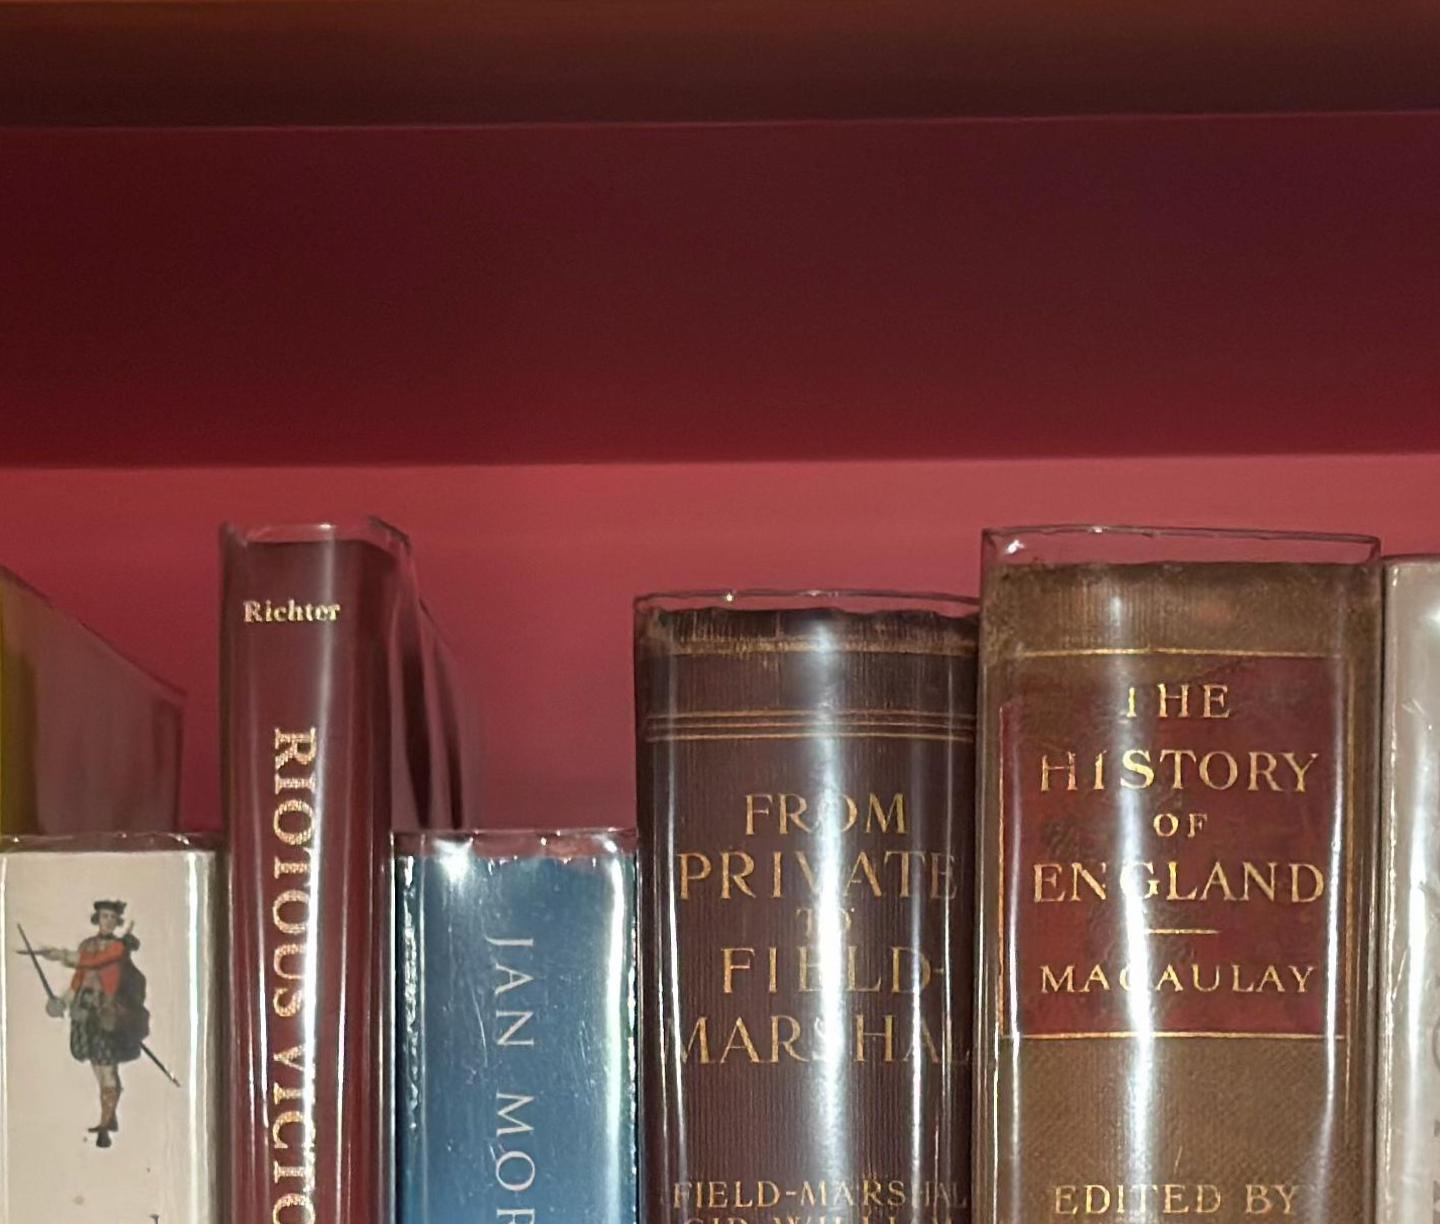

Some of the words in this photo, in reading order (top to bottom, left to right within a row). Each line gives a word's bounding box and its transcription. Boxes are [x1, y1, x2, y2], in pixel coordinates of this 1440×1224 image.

[243, 600, 341, 624] Richter
[1040, 749, 1319, 793] HISTORY
[1153, 812, 1208, 838] OF
[272, 727, 318, 1019] RIOTOUS
[677, 851, 958, 900] PRIVATE
[1032, 861, 1326, 903] ENGLAND
[485, 936, 536, 1048] JAN
[1054, 1184, 1223, 1216] EDITED
[1244, 1183, 1300, 1215] BY
